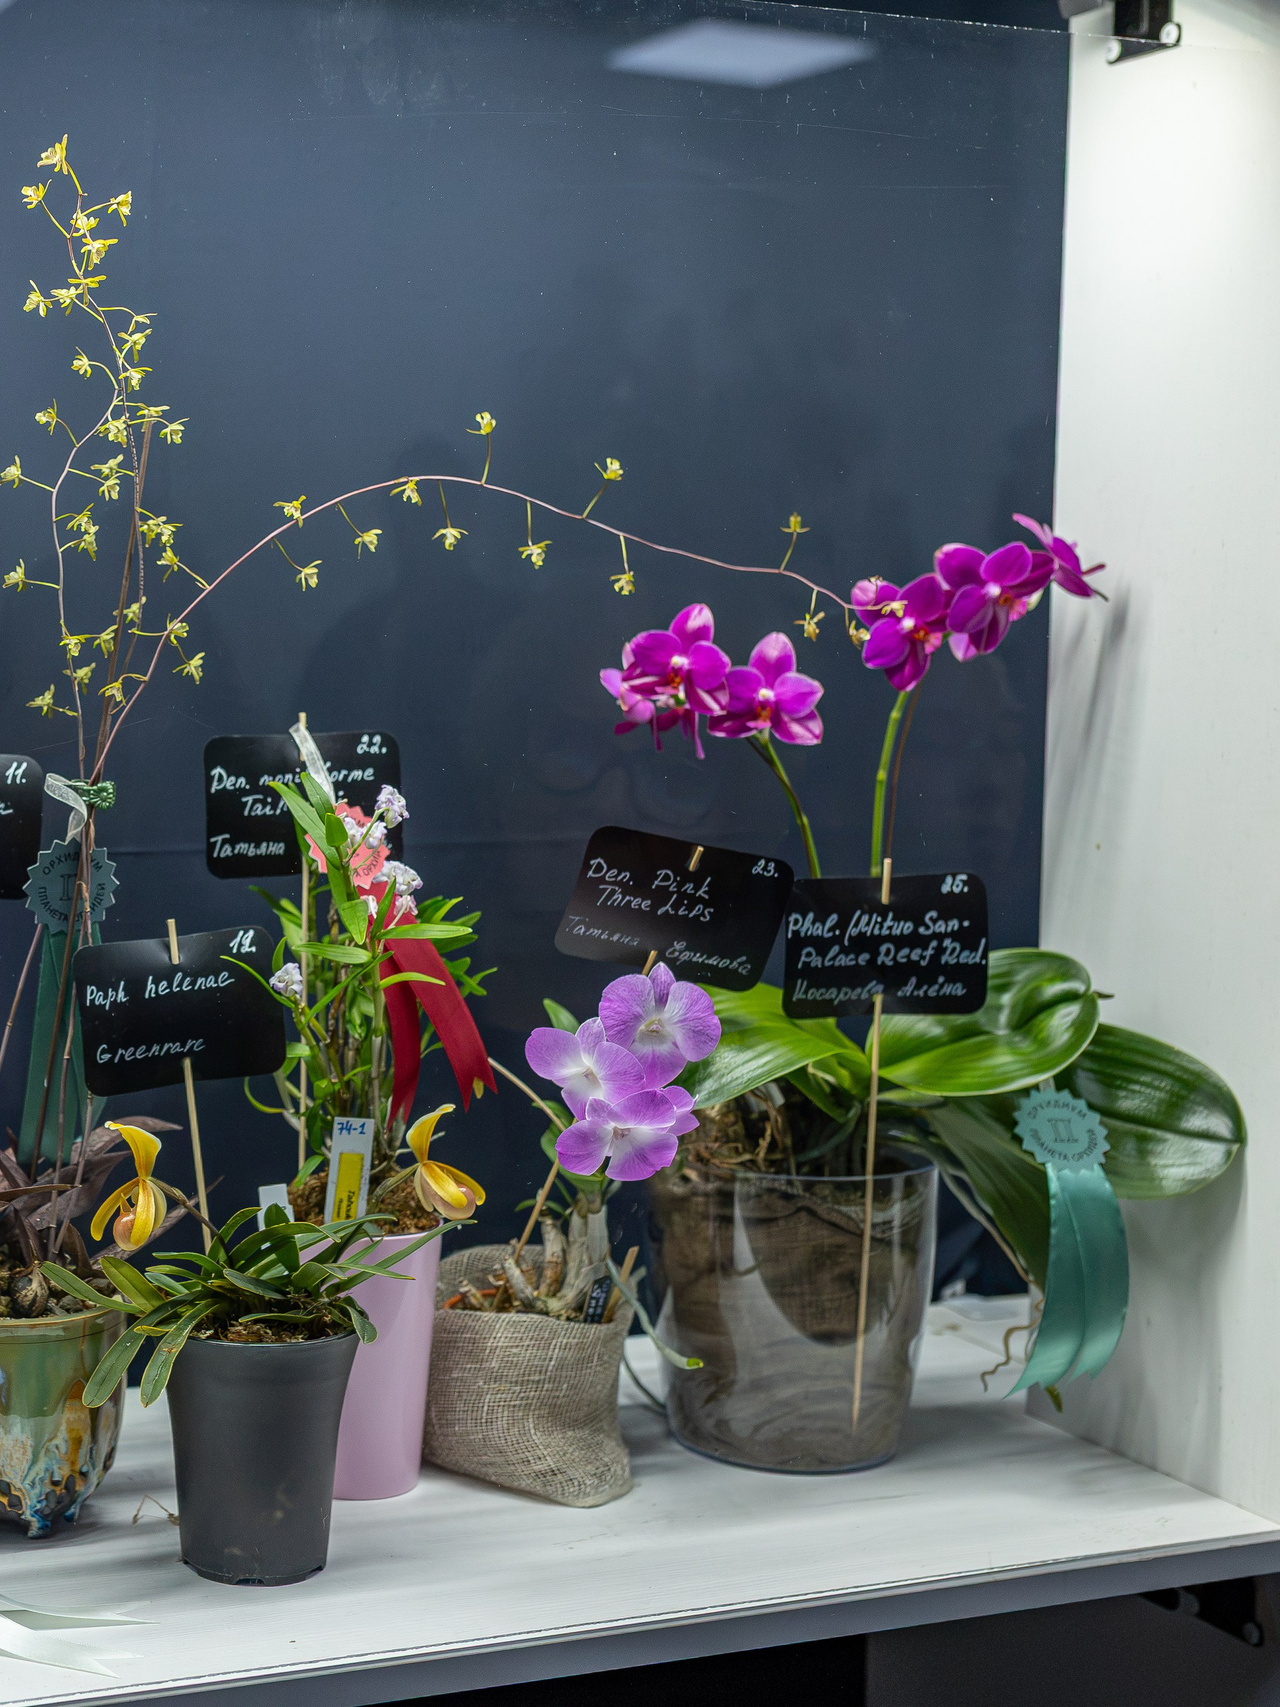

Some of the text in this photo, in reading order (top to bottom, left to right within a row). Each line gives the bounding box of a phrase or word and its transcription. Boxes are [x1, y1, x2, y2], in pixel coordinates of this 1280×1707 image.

[356, 734, 387, 754] 22.
[5, 761, 27, 784] 11.
[210, 765, 250, 794] Den.
[210, 834, 285, 858] Татьяна
[587, 858, 712, 899] Den. Pink
[752, 859, 778, 877] 23.
[597, 885, 651, 911] Three
[788, 912, 840, 939] Phal.
[564, 915, 752, 975] Татьяна Ефимова
[798, 945, 870, 969] Palace
[877, 940, 938, 966] Reef
[86, 971, 235, 1010] Paph helenae
[96, 1038, 206, 1064] Greenrare
[337, 1121, 366, 1135] 74-1
